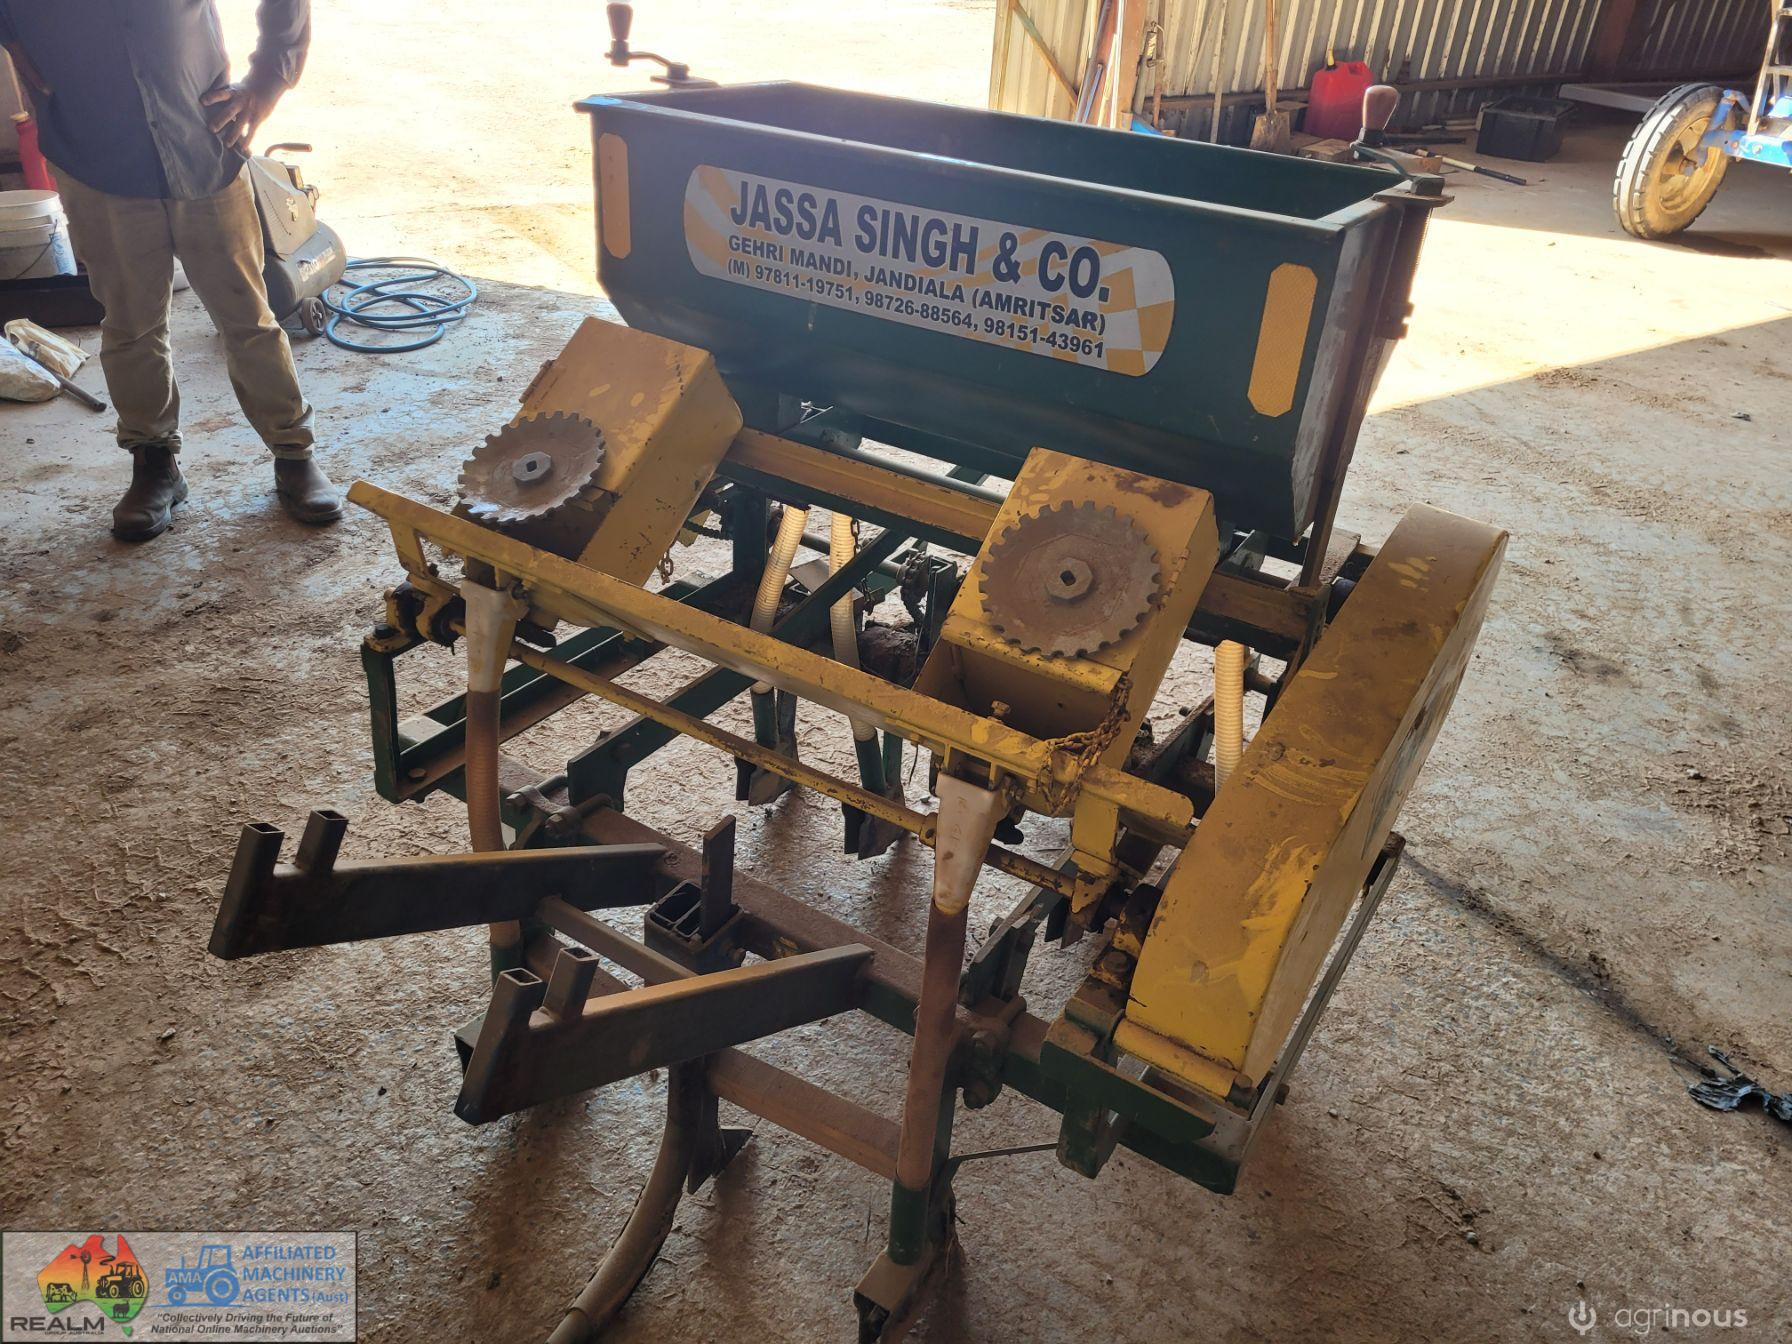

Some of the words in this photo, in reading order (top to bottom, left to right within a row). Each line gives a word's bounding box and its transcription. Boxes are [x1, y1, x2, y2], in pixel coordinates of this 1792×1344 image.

[728, 234, 784, 264] GEHRI
[789, 249, 860, 282] MANDI,
[864, 265, 965, 304] JANDIALA
[971, 286, 1106, 335] (AMRITSAR)
[730, 180, 843, 248] JASSA
[854, 204, 979, 275] SINGH
[992, 231, 1021, 285] &
[1038, 240, 1110, 303] CO.
[727, 259, 750, 280] (M)
[754, 265, 861, 305] 97811-19751,
[864, 289, 979, 333] 98726-88564,
[984, 317, 1105, 359] 98151-43961
